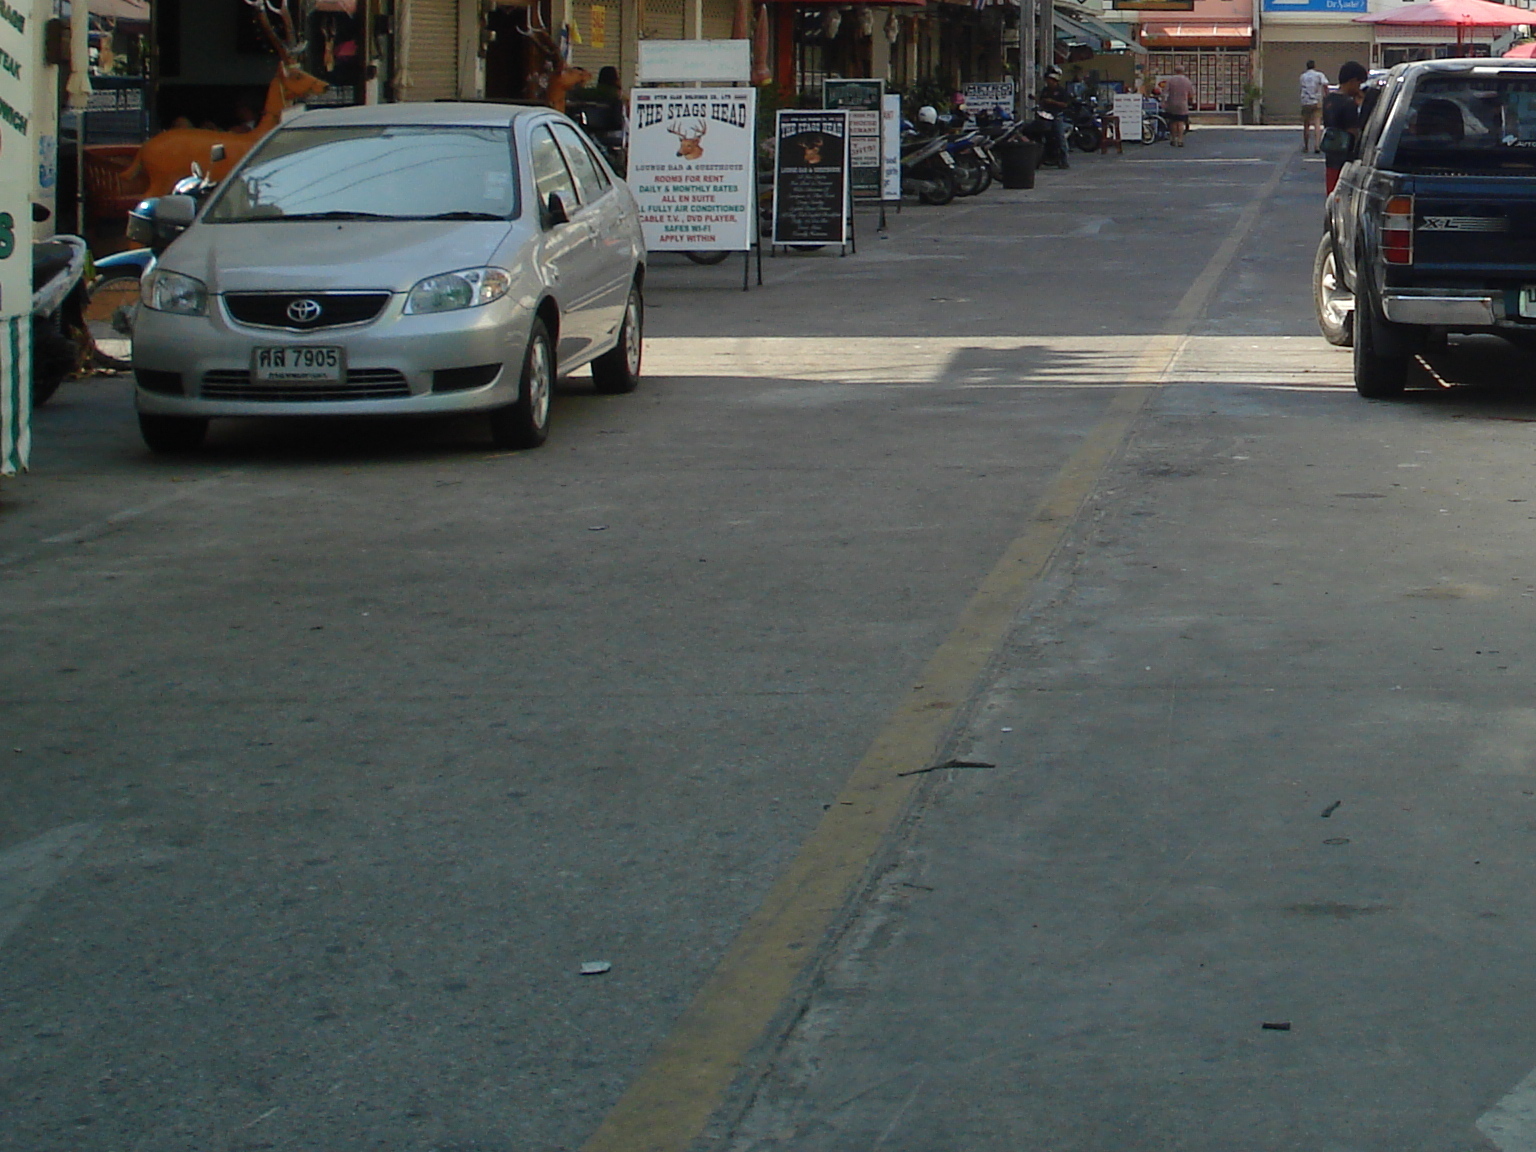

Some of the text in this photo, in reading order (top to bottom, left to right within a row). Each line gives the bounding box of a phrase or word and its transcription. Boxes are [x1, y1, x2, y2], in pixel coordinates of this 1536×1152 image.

[637, 103, 746, 128] THE STAGS HEAD
[654, 175, 683, 183] ROOMS
[685, 175, 701, 183] FOR
[293, 350, 337, 367] 7905
